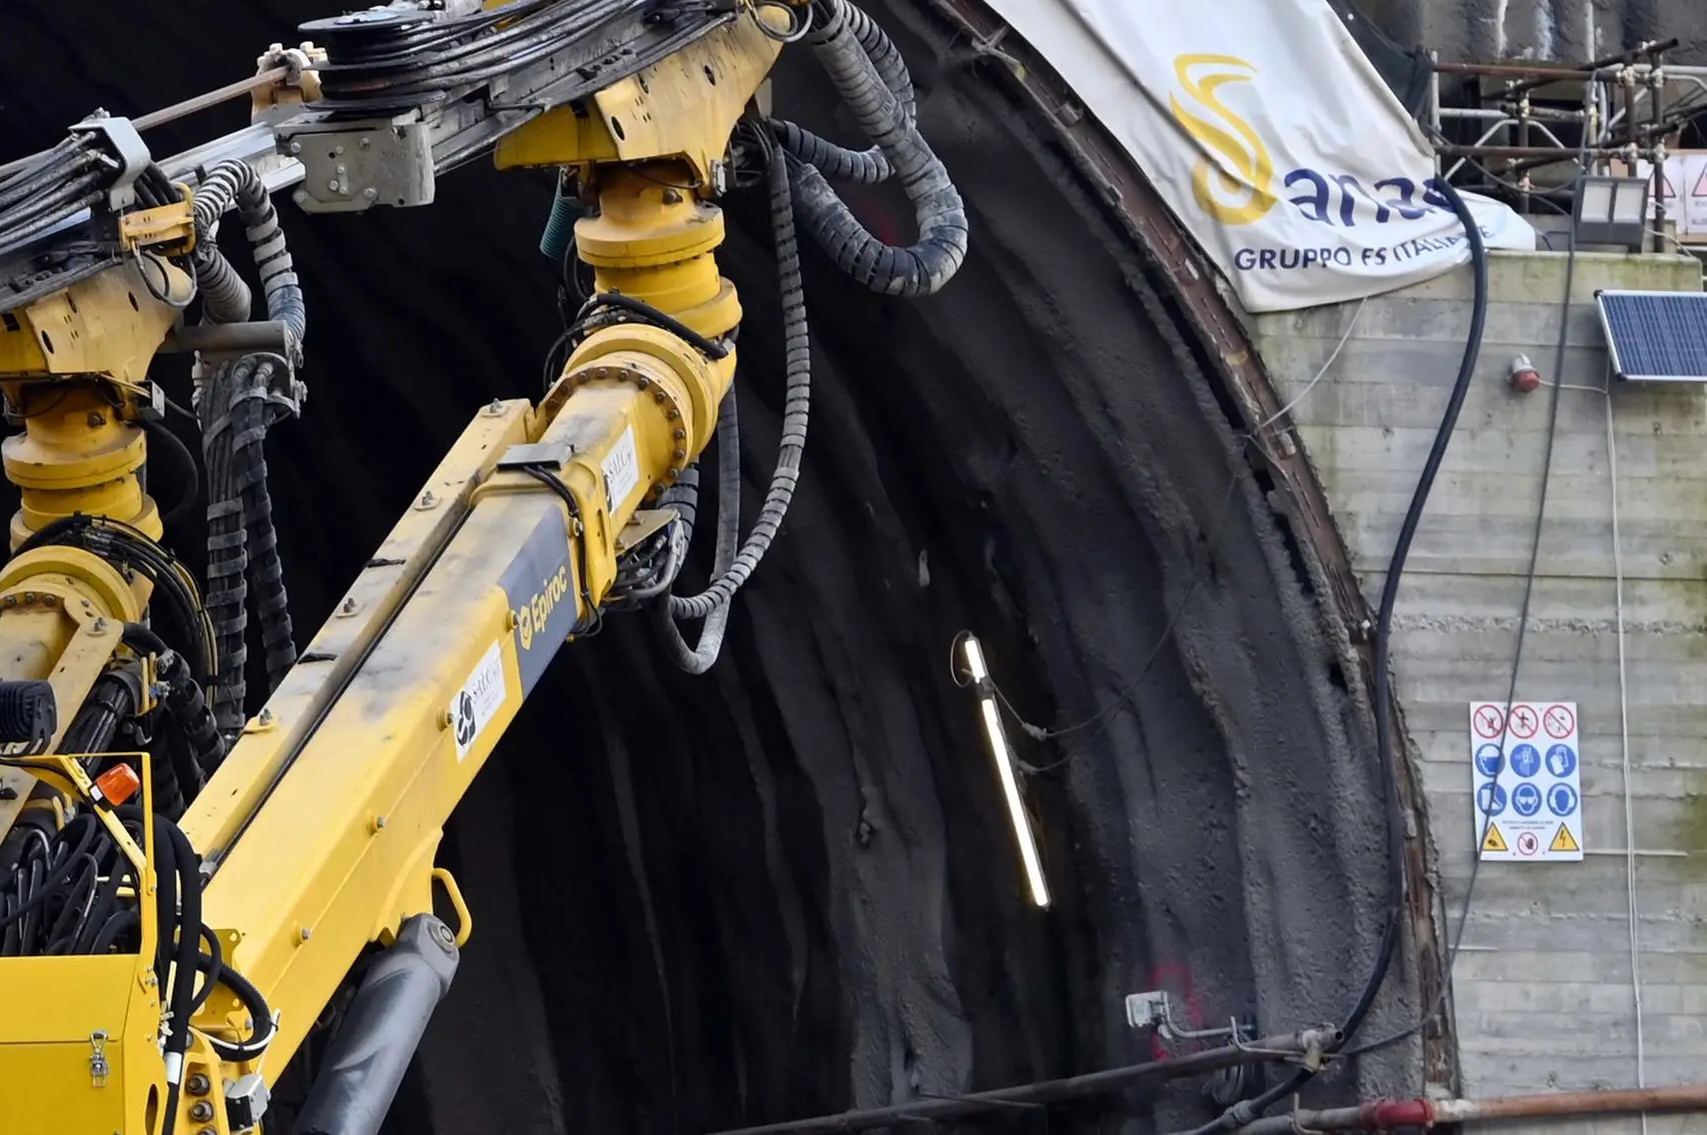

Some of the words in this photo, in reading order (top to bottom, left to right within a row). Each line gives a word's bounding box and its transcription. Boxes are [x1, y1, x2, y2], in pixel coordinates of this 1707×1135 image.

[1234, 246, 1352, 271] GRUPPO
[1361, 247, 1387, 267] FS
[1393, 225, 1495, 262] ITALIAE
[531, 565, 567, 634] Epiroc
